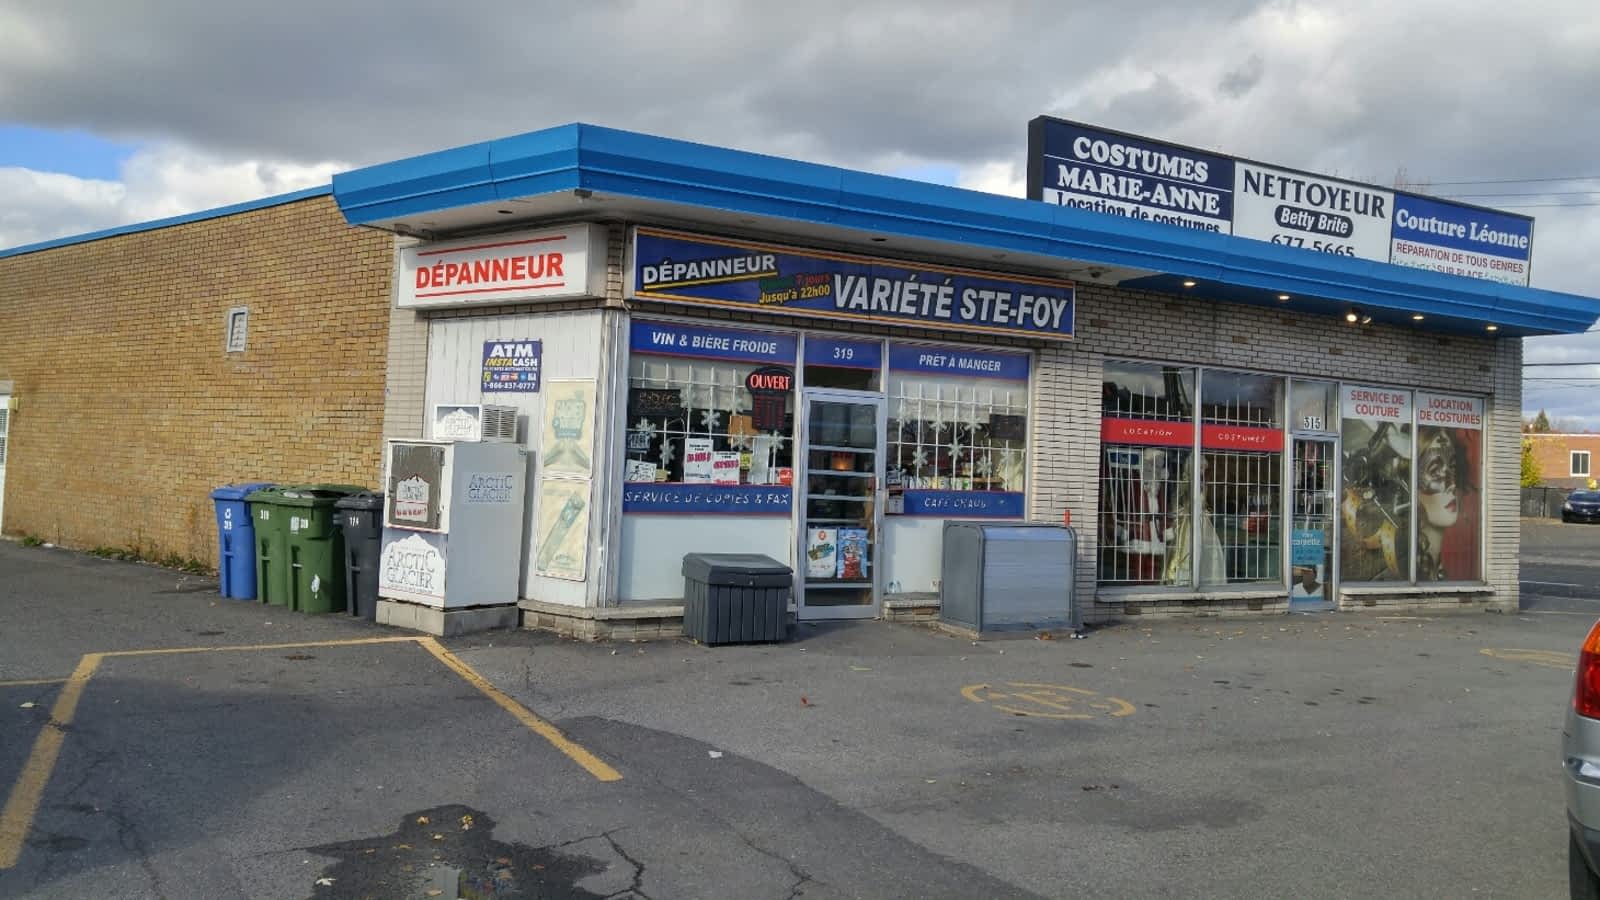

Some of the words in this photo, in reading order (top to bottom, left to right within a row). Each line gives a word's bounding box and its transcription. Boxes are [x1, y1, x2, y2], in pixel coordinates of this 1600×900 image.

[1073, 136, 1209, 183] COSTUMES
[1057, 164, 1220, 215] MARIE-ANNE
[1243, 169, 1385, 219] NETTOYEUR
[1056, 192, 1126, 217] Location
[1131, 206, 1149, 221] de
[1280, 207, 1315, 231] Betty
[1318, 214, 1348, 234] Brite
[1396, 208, 1466, 238] Couture
[1470, 219, 1529, 249] Léonne
[416, 252, 564, 289] DÉPANNEUR
[643, 253, 776, 284] DÉPANNEUR
[1451, 252, 1463, 264] DE
[1466, 255, 1488, 268] TOUS
[1489, 259, 1524, 274] GENRES
[800, 284, 831, 298] 22h00
[833, 272, 955, 318] VARIÉTÉ
[960, 288, 1067, 329] STE-FOY
[490, 343, 534, 358] ATM
[652, 331, 676, 345] VIN
[679, 334, 688, 347] &
[733, 339, 777, 354] FROIDE
[833, 347, 854, 360] 319
[484, 358, 538, 367] INSTACASH
[958, 357, 1001, 372] MANGER
[750, 374, 791, 390] OUVERT
[1351, 389, 1389, 404] SERVICE
[1392, 394, 1405, 405] DE
[1429, 398, 1473, 412] LOCATION
[1355, 404, 1400, 418] COUTURE
[1420, 409, 1432, 420] DE
[1434, 411, 1481, 425] COSTUMES
[1304, 416, 1321, 430] 315
[1123, 428, 1173, 437] LOCATION
[1217, 433, 1266, 443] COSTUMES
[468, 474, 513, 489] ARCTIC
[766, 493, 789, 505] FAX
[386, 544, 436, 573] ARCTIC
